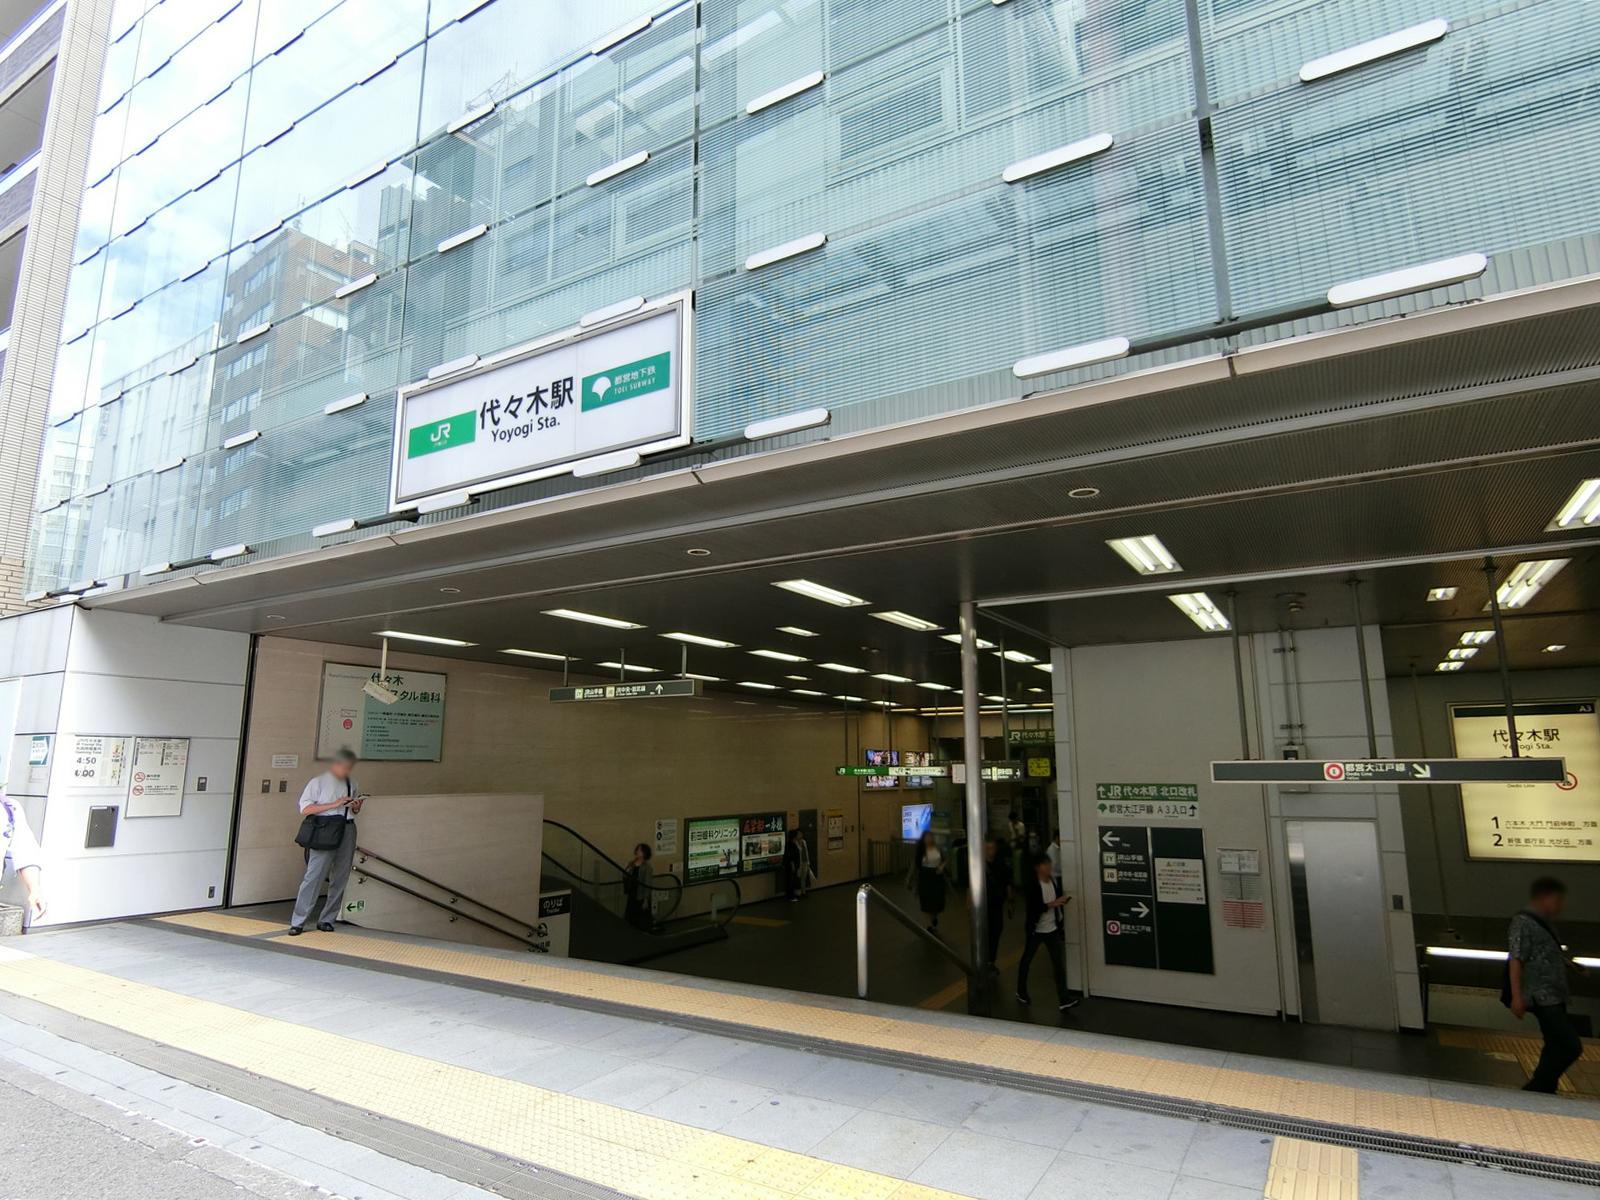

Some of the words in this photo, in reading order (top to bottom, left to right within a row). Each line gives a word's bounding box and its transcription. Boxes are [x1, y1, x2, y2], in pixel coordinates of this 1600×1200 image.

[613, 364, 657, 386] 都営地下鉄
[613, 384, 629, 396] TOEI
[630, 378, 656, 391] SUBWAY
[480, 376, 574, 430] 代々木駅
[430, 422, 451, 443] JR
[491, 419, 534, 443] Yoyogi
[537, 414, 561, 433] Sta.
[371, 672, 404, 686] 代々木
[1009, 731, 1021, 740] JR
[1022, 731, 1046, 739] 代々木駅
[1492, 728, 1560, 742] 代々木駅
[76, 756, 97, 764] 4:50
[1346, 763, 1406, 772] 都営大江戸線
[1108, 786, 1122, 796] JR
[1123, 786, 1158, 796] 代々木駅
[1160, 786, 1197, 796] 北口改札
[1109, 804, 1154, 814] 都営大江戸線
[1491, 816, 1500, 829] 1
[690, 828, 738, 842] 前田眼科クリニック
[1492, 834, 1504, 846] 2
[543, 896, 564, 909] のりば
